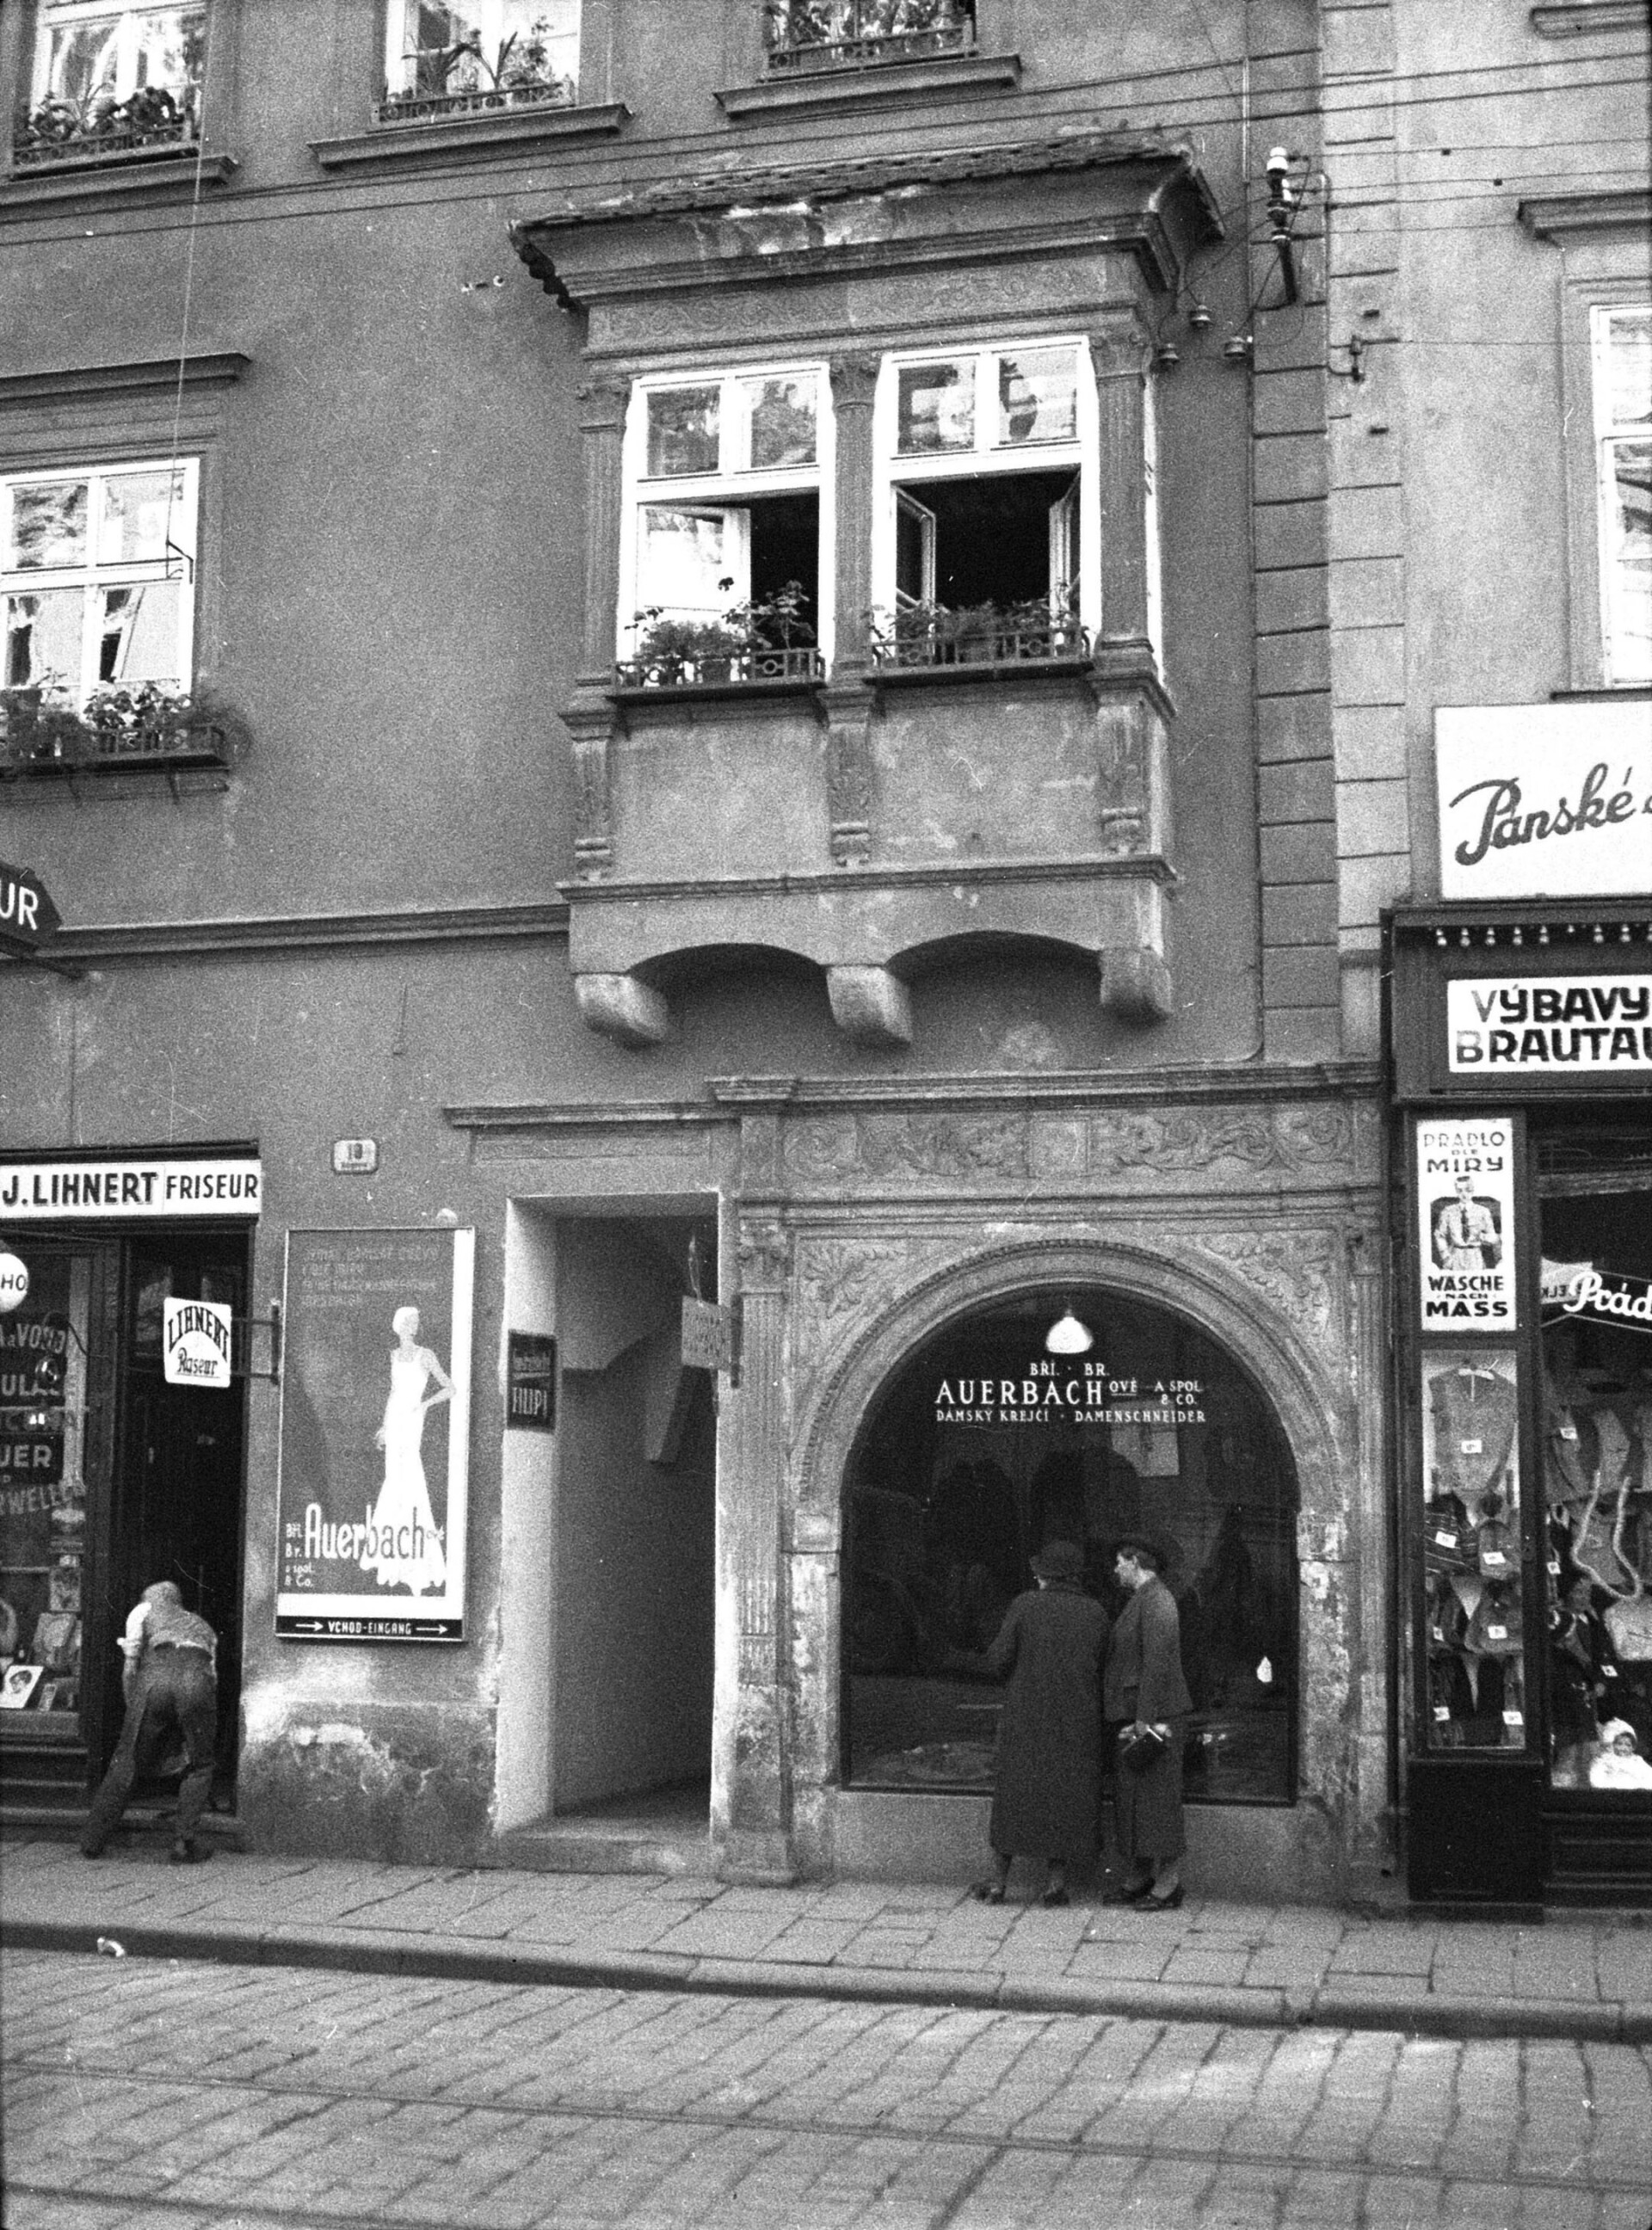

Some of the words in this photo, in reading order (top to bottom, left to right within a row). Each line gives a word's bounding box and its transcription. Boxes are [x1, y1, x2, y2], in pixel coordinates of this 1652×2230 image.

[0, 880, 39, 931] UR
[1470, 983, 1650, 1025] VÝBAVY
[166, 1174, 258, 1199] FRISEUR
[1426, 1301, 1508, 1317] MASS
[168, 1305, 229, 1363] LIHNERT
[934, 1380, 1102, 1405] AUERBACH
[1154, 1381, 1164, 1392] A
[1075, 1410, 1206, 1423] DAMENSCHNEIDER
[305, 1502, 424, 1560] Auerbach
